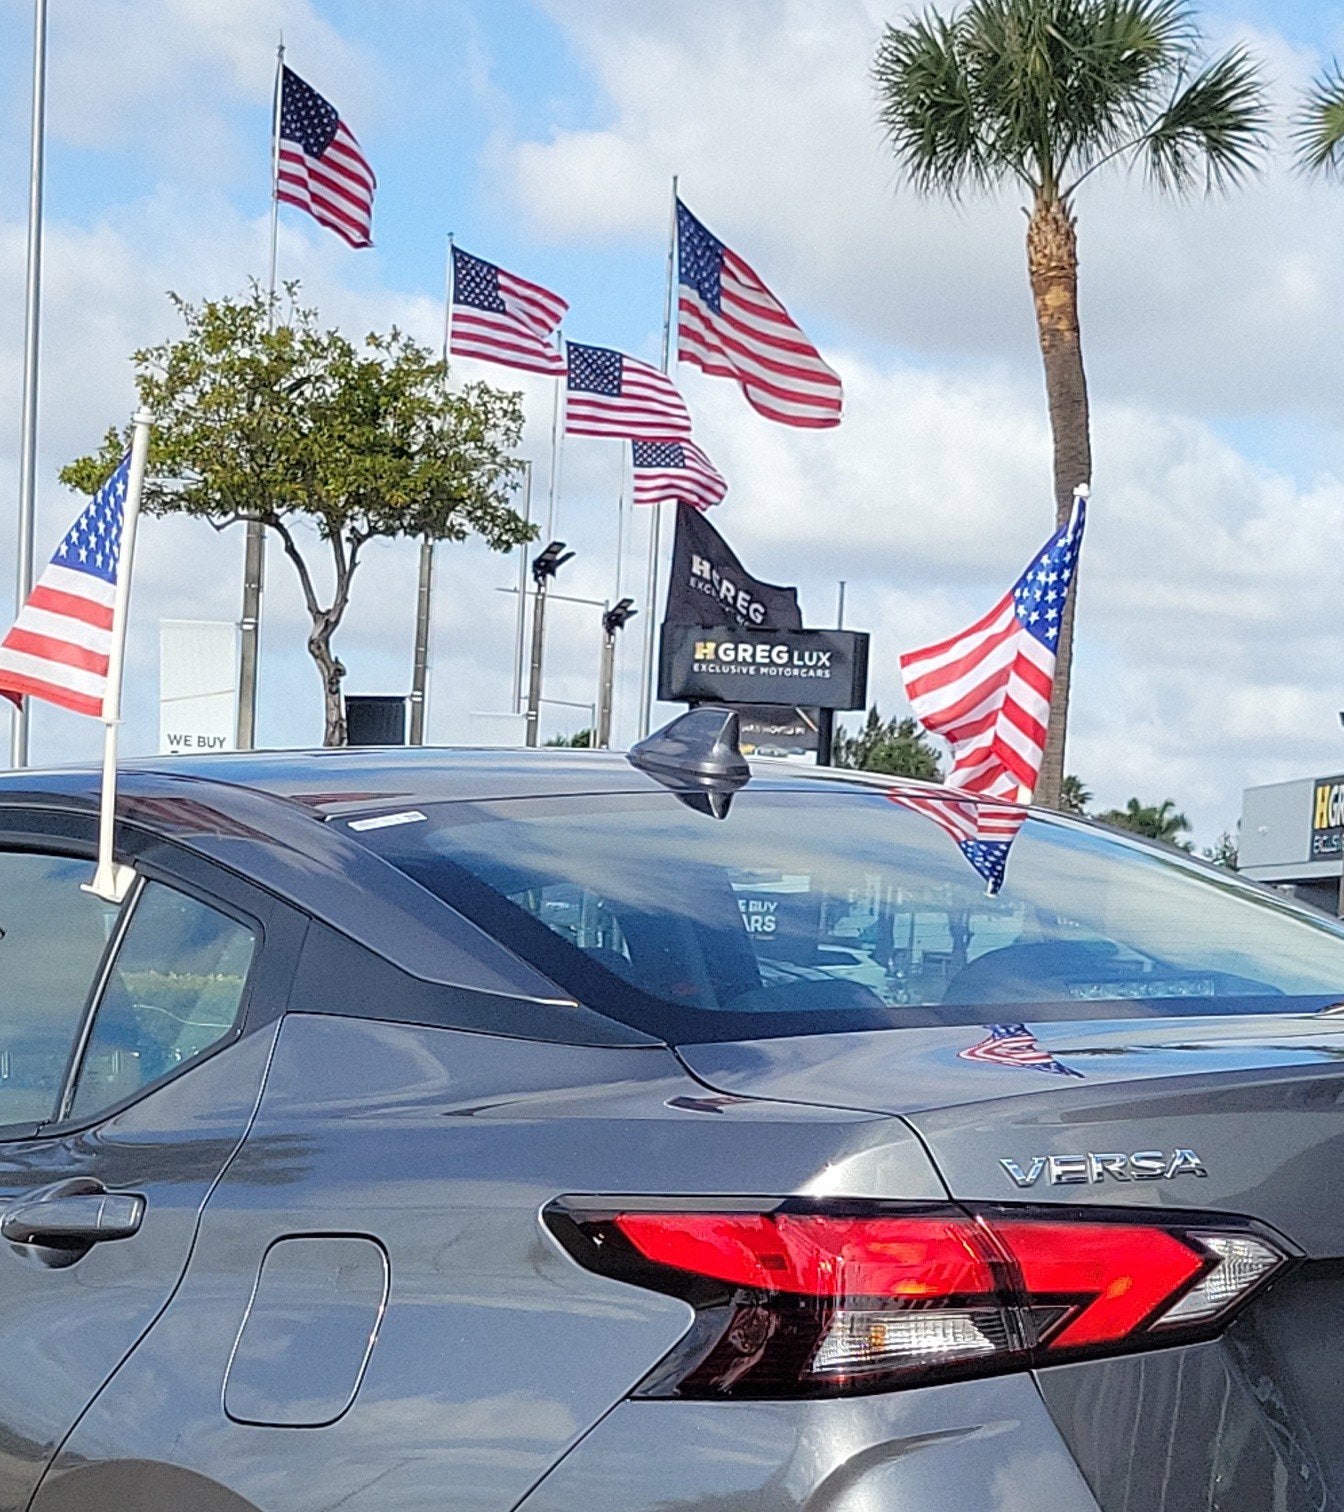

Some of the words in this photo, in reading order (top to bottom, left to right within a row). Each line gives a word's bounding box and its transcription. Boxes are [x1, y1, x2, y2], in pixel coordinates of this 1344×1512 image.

[694, 641, 789, 665] HGREG
[792, 650, 832, 668] LUX
[692, 663, 757, 676] EXCLUSIVE
[759, 666, 832, 679] MOTORCARS
[167, 733, 193, 748] WE
[197, 735, 227, 750] BUY
[998, 1147, 1208, 1188] VERSA
